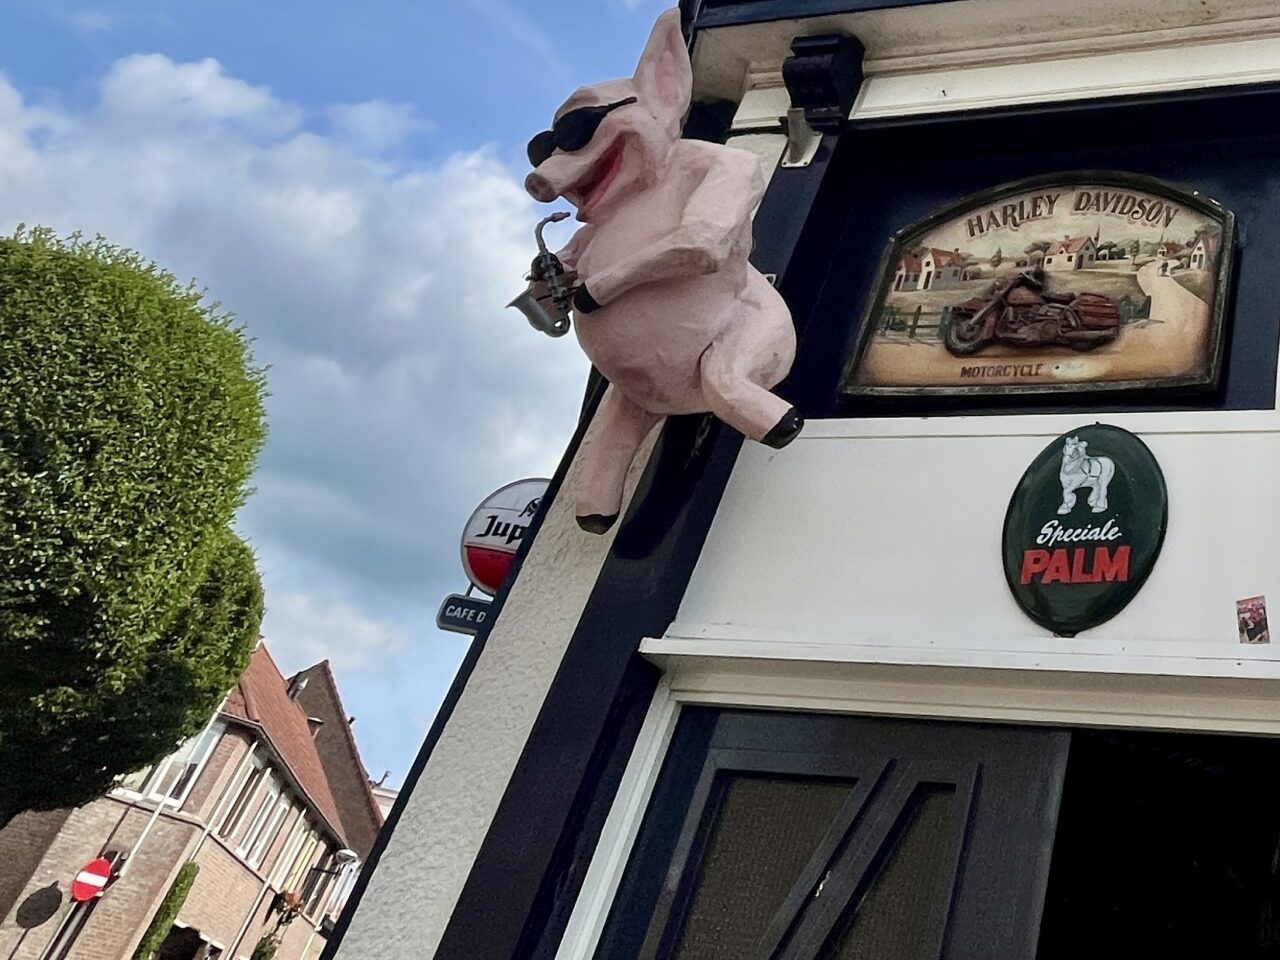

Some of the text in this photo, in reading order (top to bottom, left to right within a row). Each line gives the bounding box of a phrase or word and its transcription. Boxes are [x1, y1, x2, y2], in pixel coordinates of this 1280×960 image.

[966, 191, 1180, 238] HARLEY DAVIDSON
[960, 363, 1044, 378] MOTORCYCLE
[1036, 519, 1123, 547] Speciale
[1020, 545, 1132, 586] PALM
[445, 605, 477, 621] CAFE
